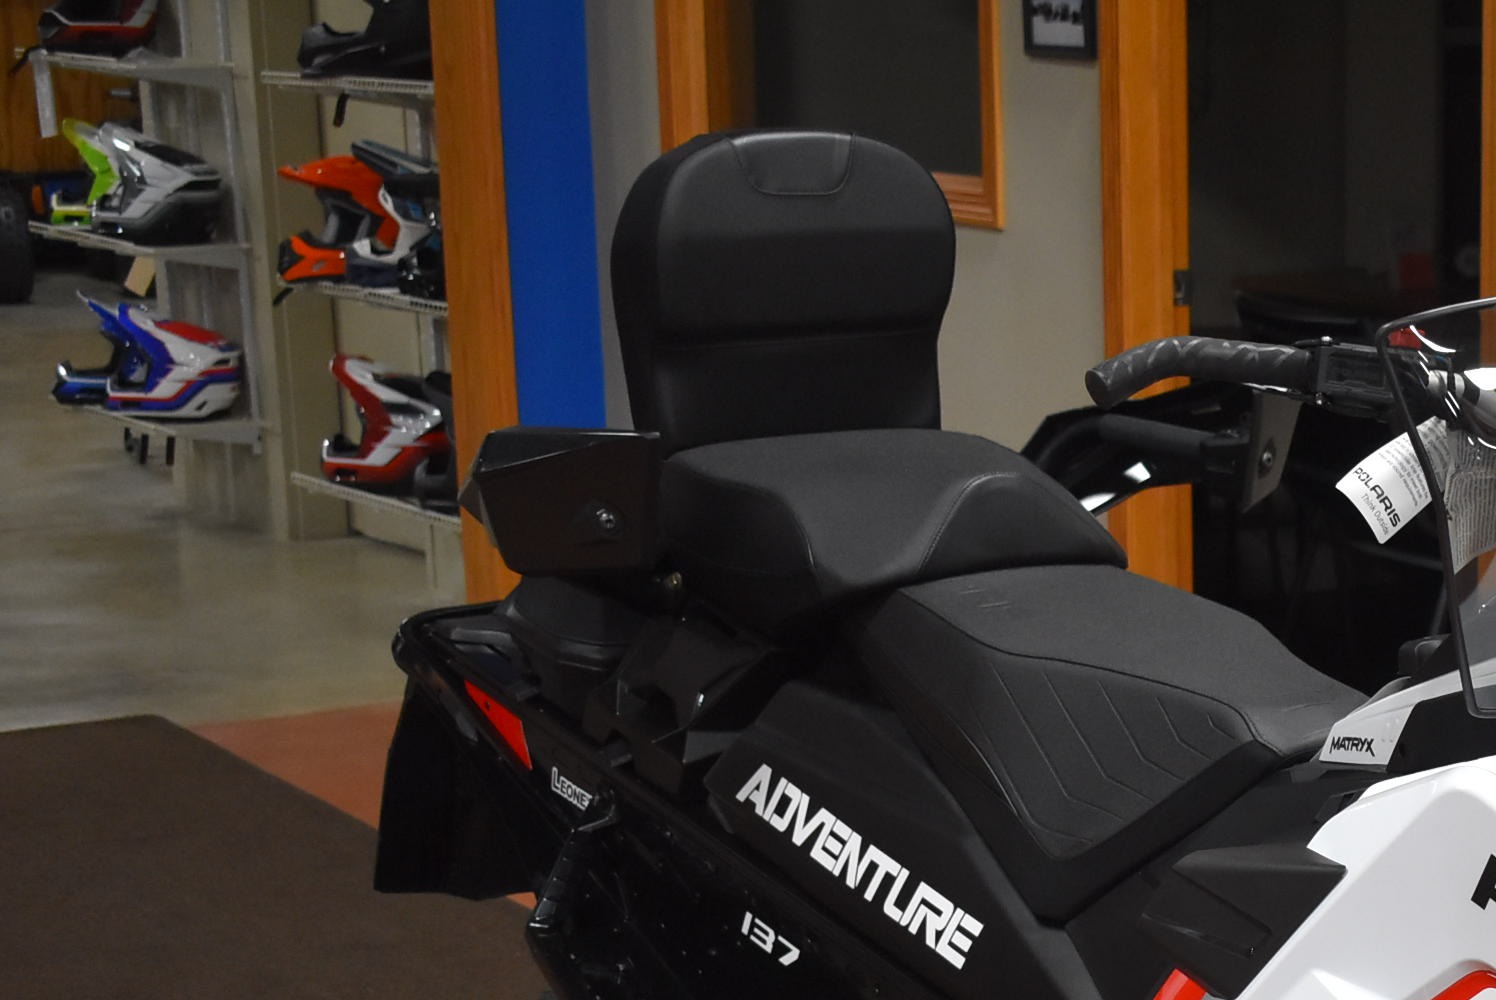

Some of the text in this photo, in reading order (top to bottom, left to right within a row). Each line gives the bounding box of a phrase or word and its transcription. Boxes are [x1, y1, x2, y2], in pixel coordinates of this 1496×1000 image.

[1353, 467, 1401, 527] POLARIS
[1329, 736, 1375, 757] MATRYX
[735, 763, 984, 970] ADVENTURE
[741, 911, 800, 966] 137
